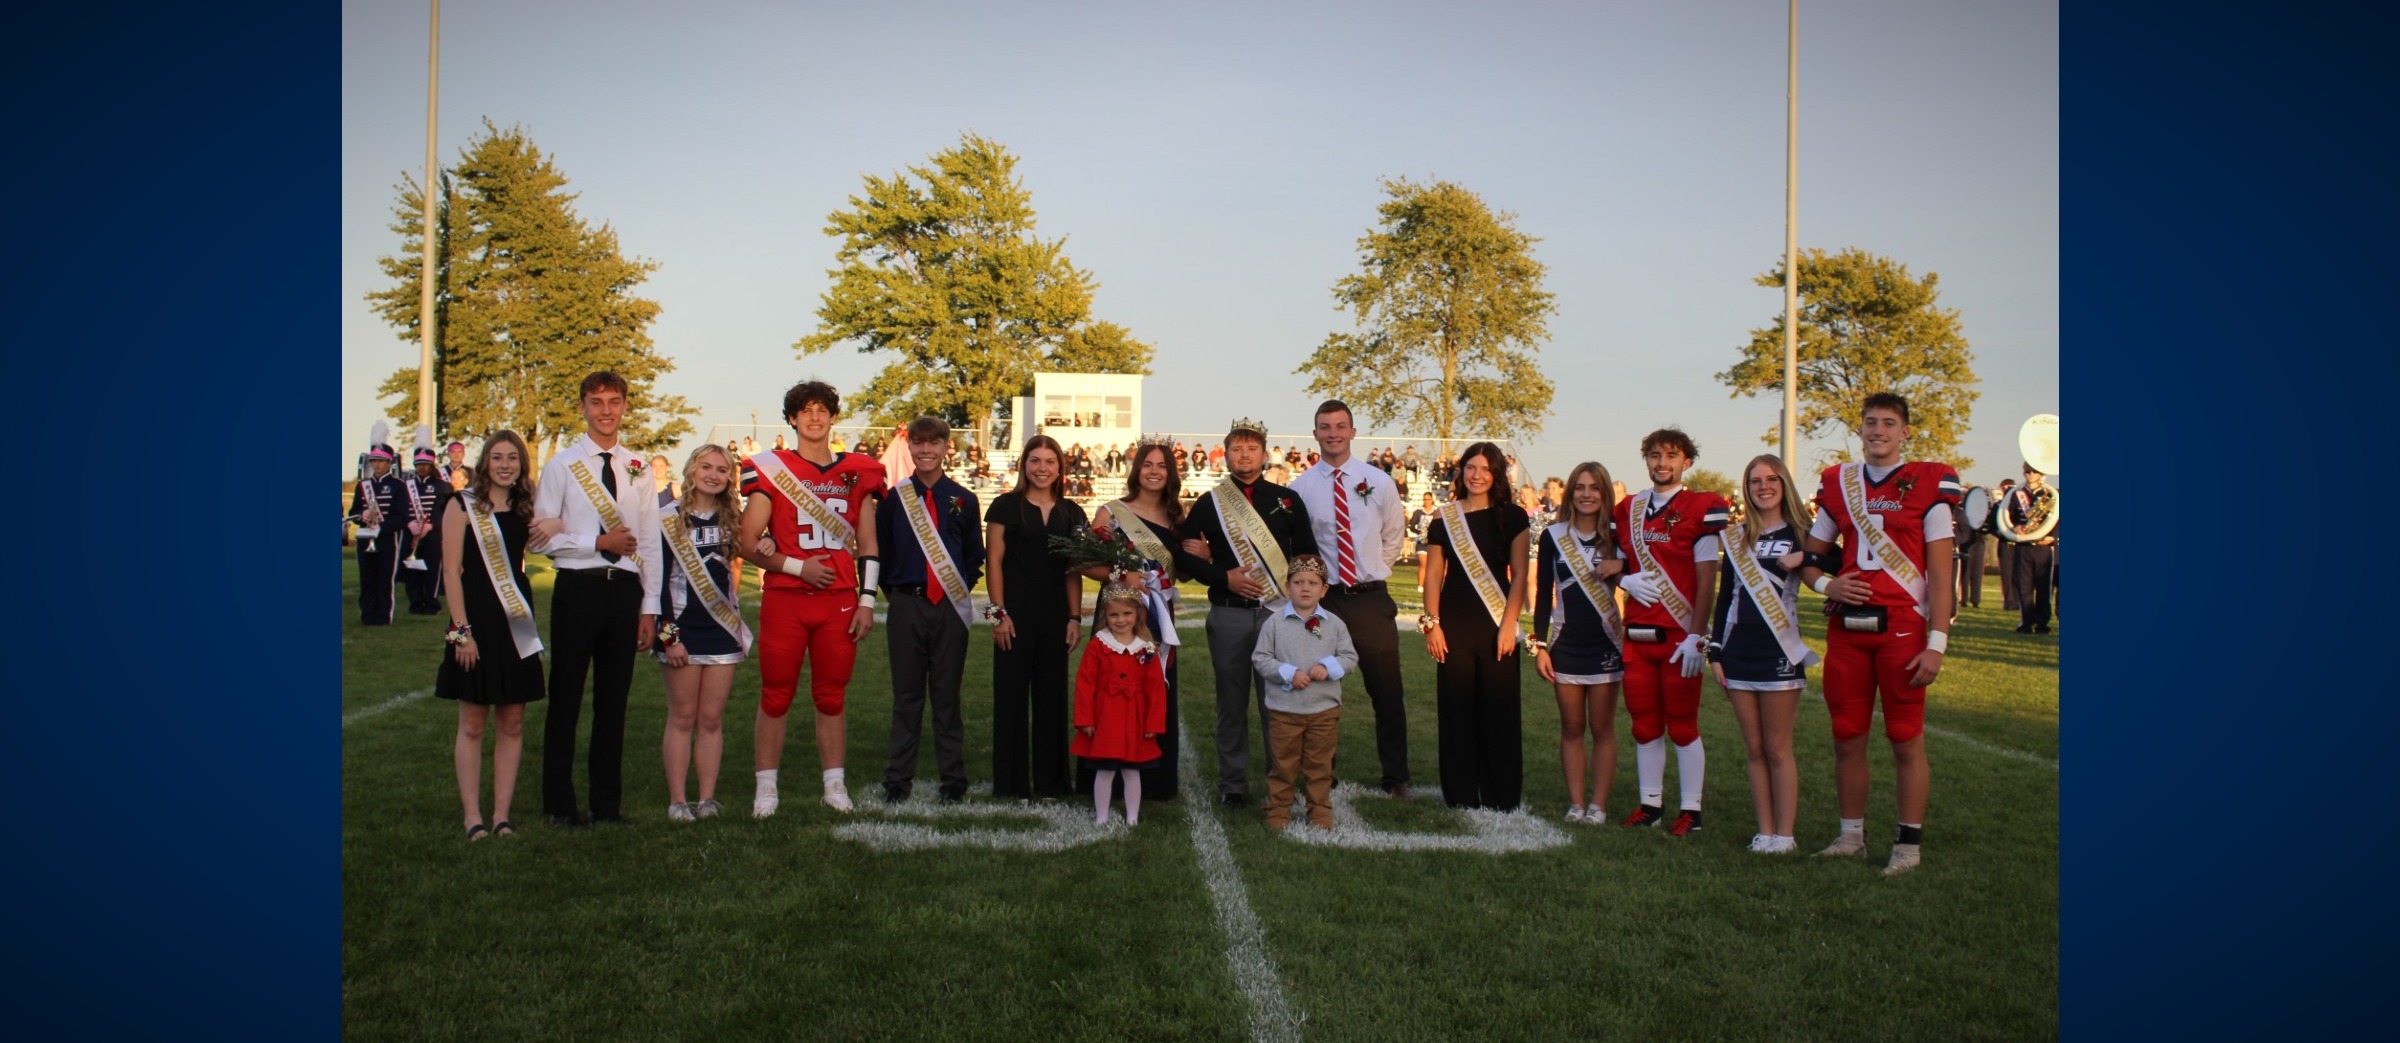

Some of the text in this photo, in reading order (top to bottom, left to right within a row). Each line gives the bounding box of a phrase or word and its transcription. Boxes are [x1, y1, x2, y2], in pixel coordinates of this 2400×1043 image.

[568, 459, 623, 529] HOMECOM
[773, 468, 847, 540] HOMECOMING
[797, 497, 848, 551] 56
[1865, 495, 1902, 511] iders
[661, 514, 719, 604] HOMECOMING
[900, 482, 967, 603] HOMECOMING COURT
[1251, 522, 1273, 549] KING
[1443, 502, 1486, 580] HOMECOMING
[1755, 540, 1794, 558] HS
[1876, 542, 1919, 585] COURT
[500, 581, 529, 622] COURT
[1557, 534, 1614, 614] HOMECOMING
[1656, 579, 1691, 621] COURT
[1723, 526, 1791, 631] MECOMING COURT
